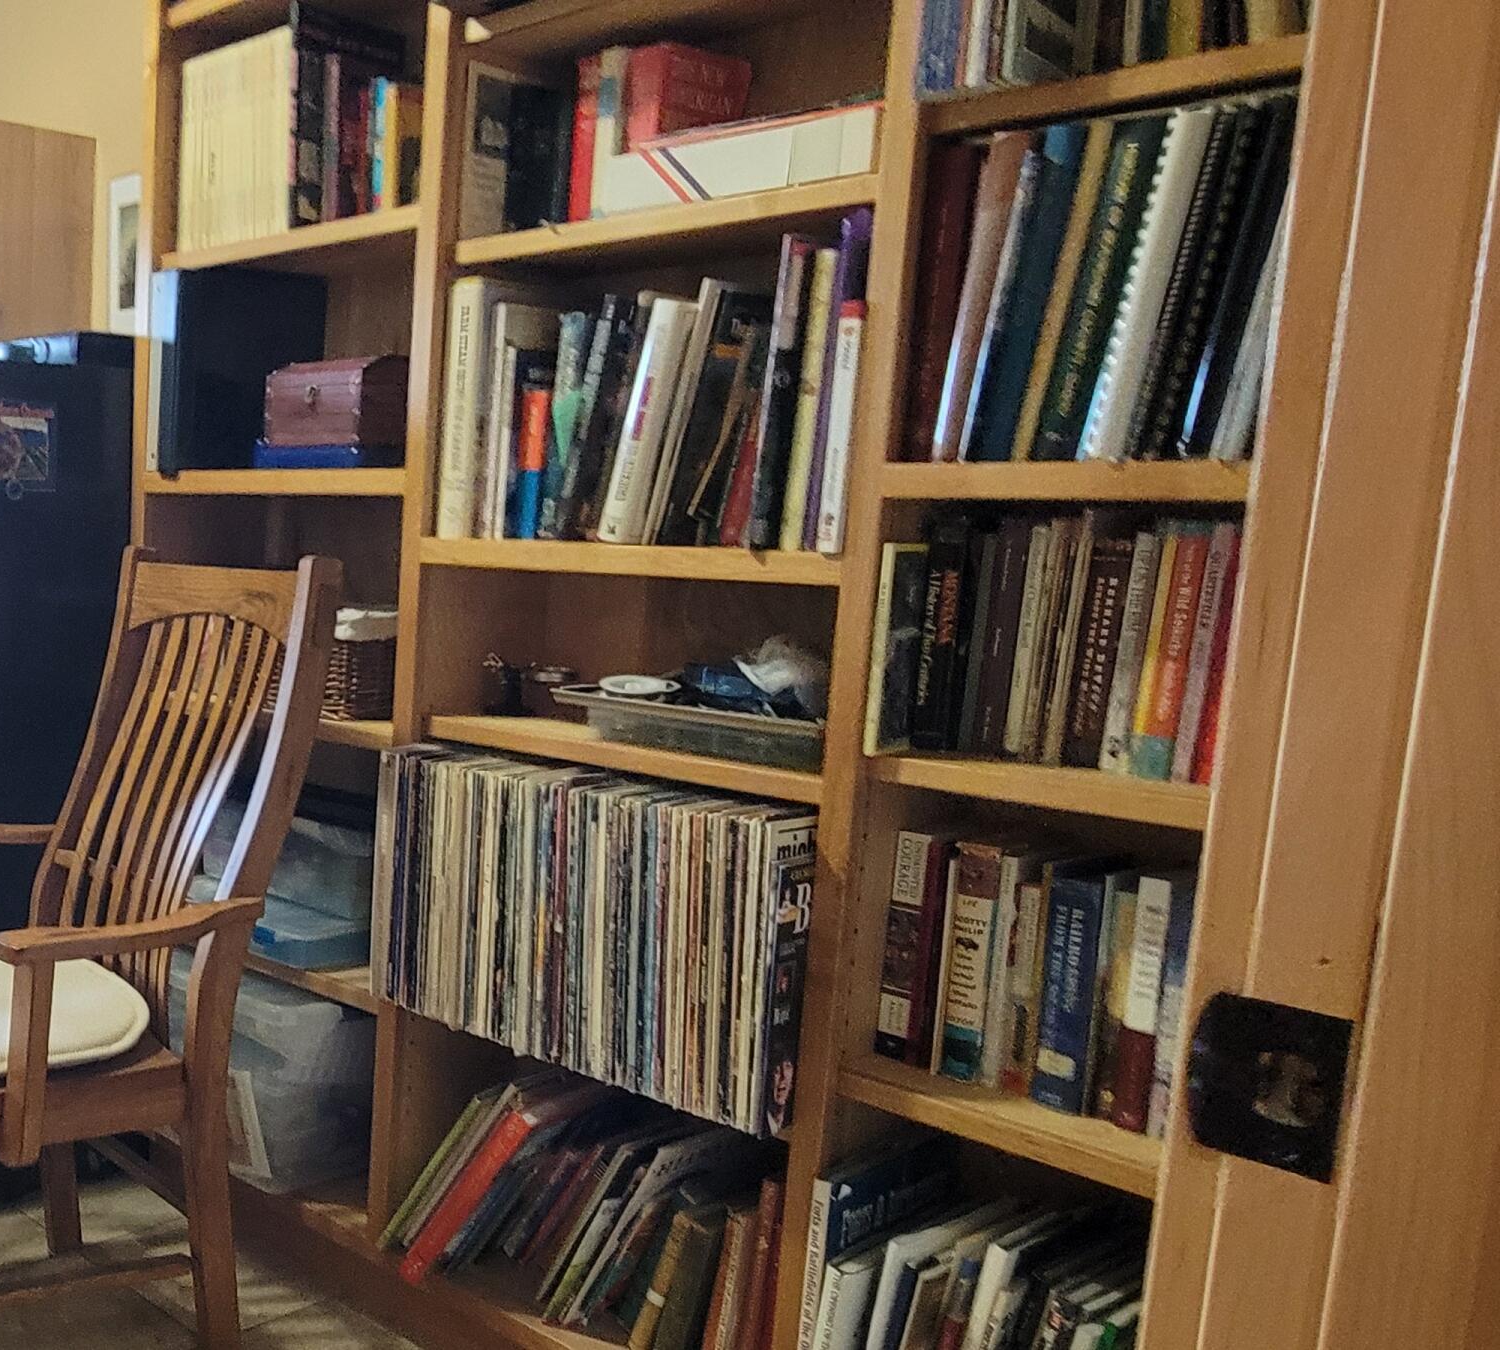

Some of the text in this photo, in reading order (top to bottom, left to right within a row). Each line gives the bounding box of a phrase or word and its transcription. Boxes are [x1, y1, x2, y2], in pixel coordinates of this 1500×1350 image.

[926, 581, 940, 616] History
[939, 570, 959, 645] MONTANA
[922, 633, 935, 654] Two
[916, 655, 932, 706] Centuries
[895, 837, 912, 896] COURAGE
[908, 840, 924, 899] UNDAUNTED
[811, 1199, 825, 1226] Forts
[809, 1229, 821, 1248] and
[804, 1250, 820, 1306] Battlefields
